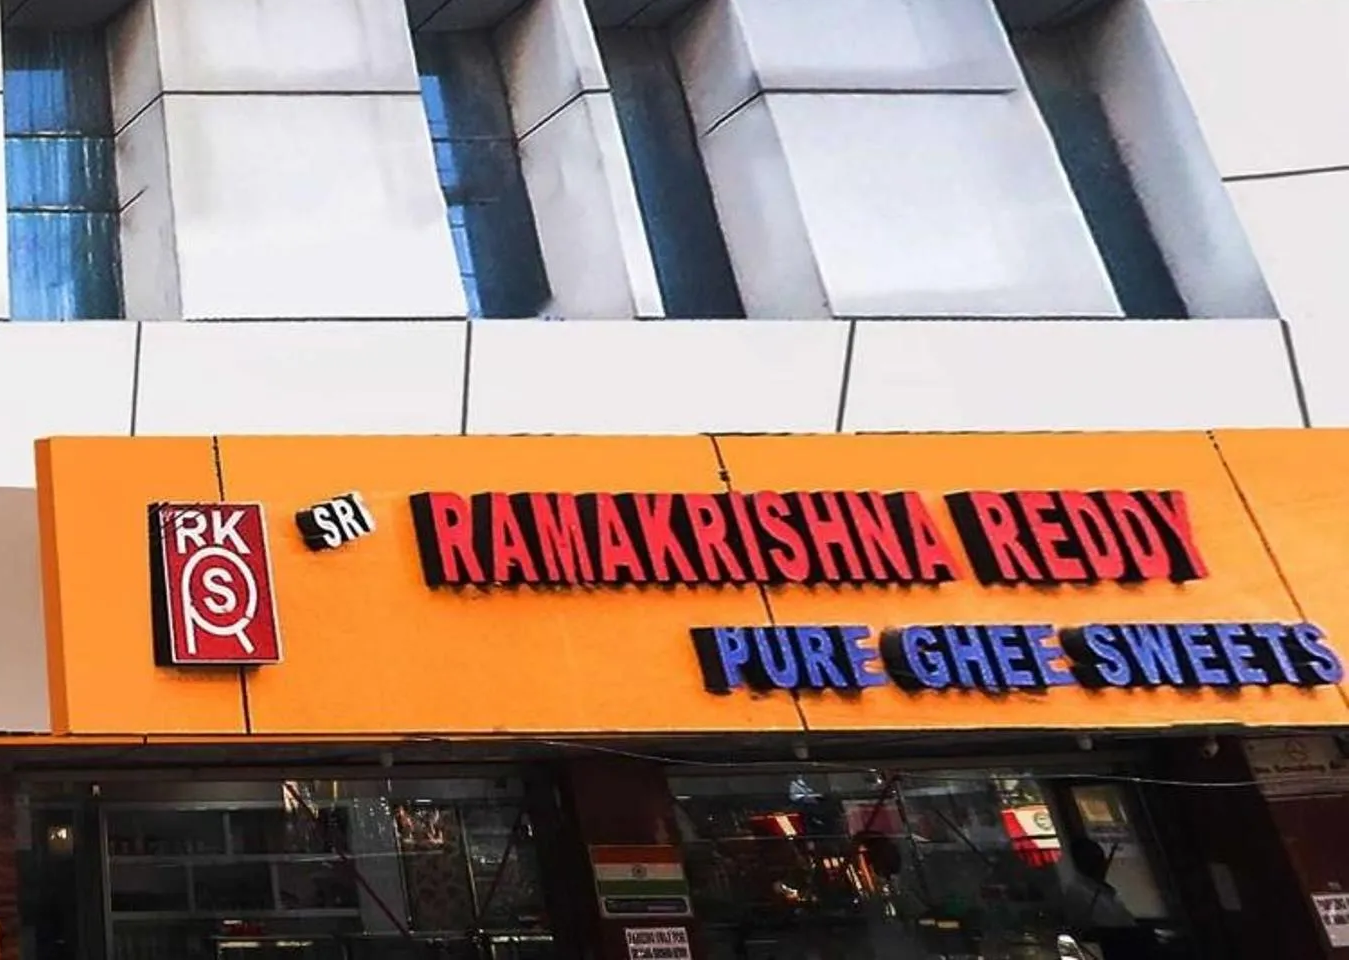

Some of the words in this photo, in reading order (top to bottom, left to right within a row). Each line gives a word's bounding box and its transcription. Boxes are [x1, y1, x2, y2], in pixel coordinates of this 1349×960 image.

[173, 508, 252, 556] RK
[308, 491, 377, 551] SRI
[420, 490, 956, 585] RAMAKRISHNA
[962, 490, 1210, 582] REDDY
[702, 624, 886, 691] PURE
[890, 623, 1075, 691] GHEE
[1074, 622, 1345, 689] SWEETS
